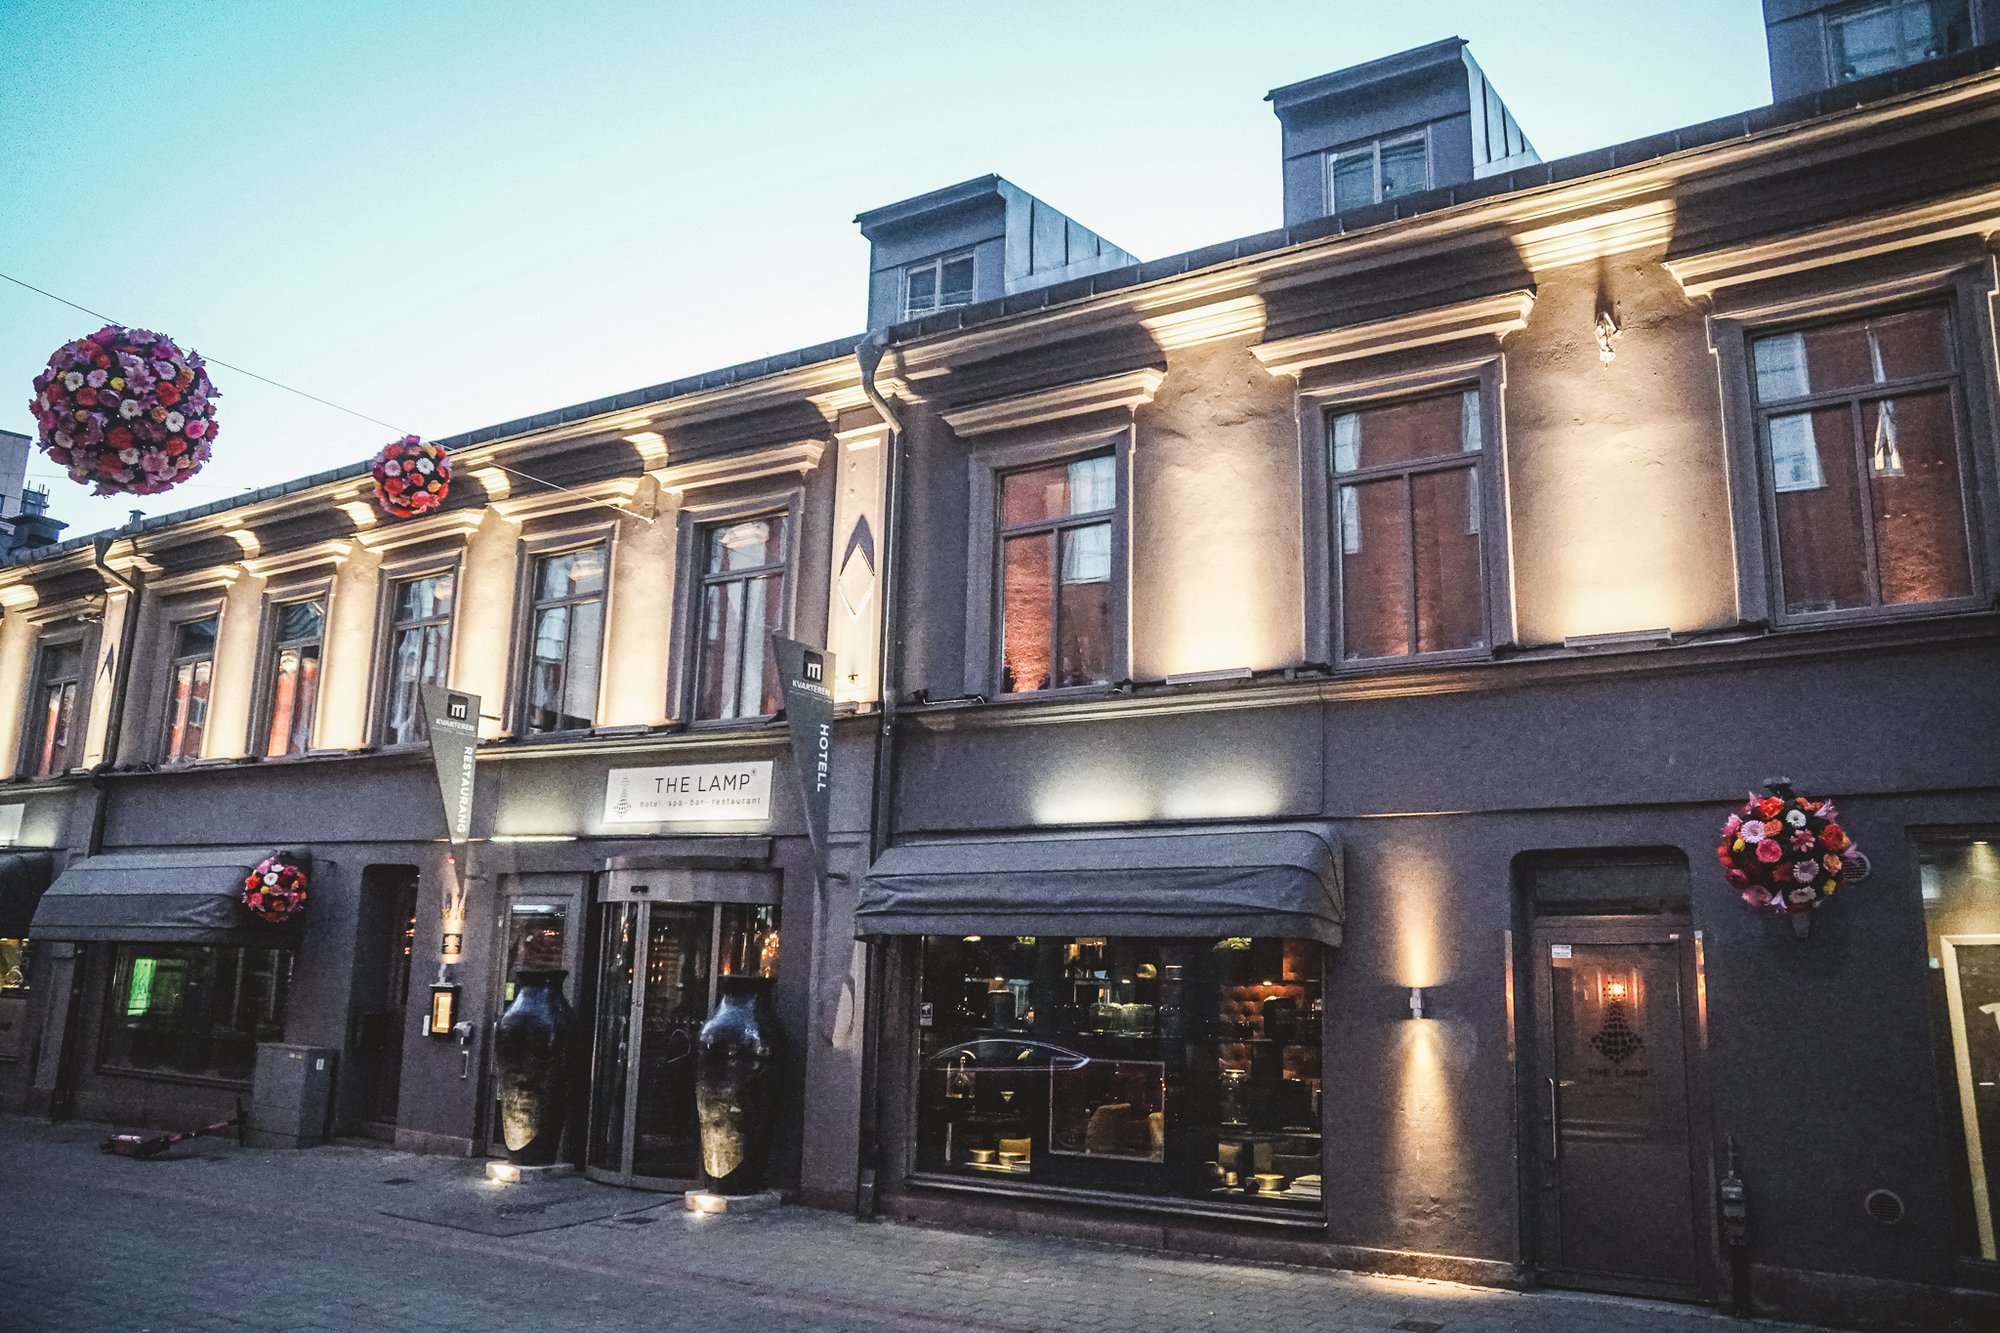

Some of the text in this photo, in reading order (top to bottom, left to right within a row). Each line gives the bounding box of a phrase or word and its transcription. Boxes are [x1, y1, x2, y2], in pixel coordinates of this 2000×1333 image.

[792, 679, 830, 697] KVARTEREN
[817, 723, 830, 792] HOTELL
[456, 745, 474, 833] RESTAURANG
[655, 776, 691, 793] THE
[711, 797, 761, 806] restaurant
